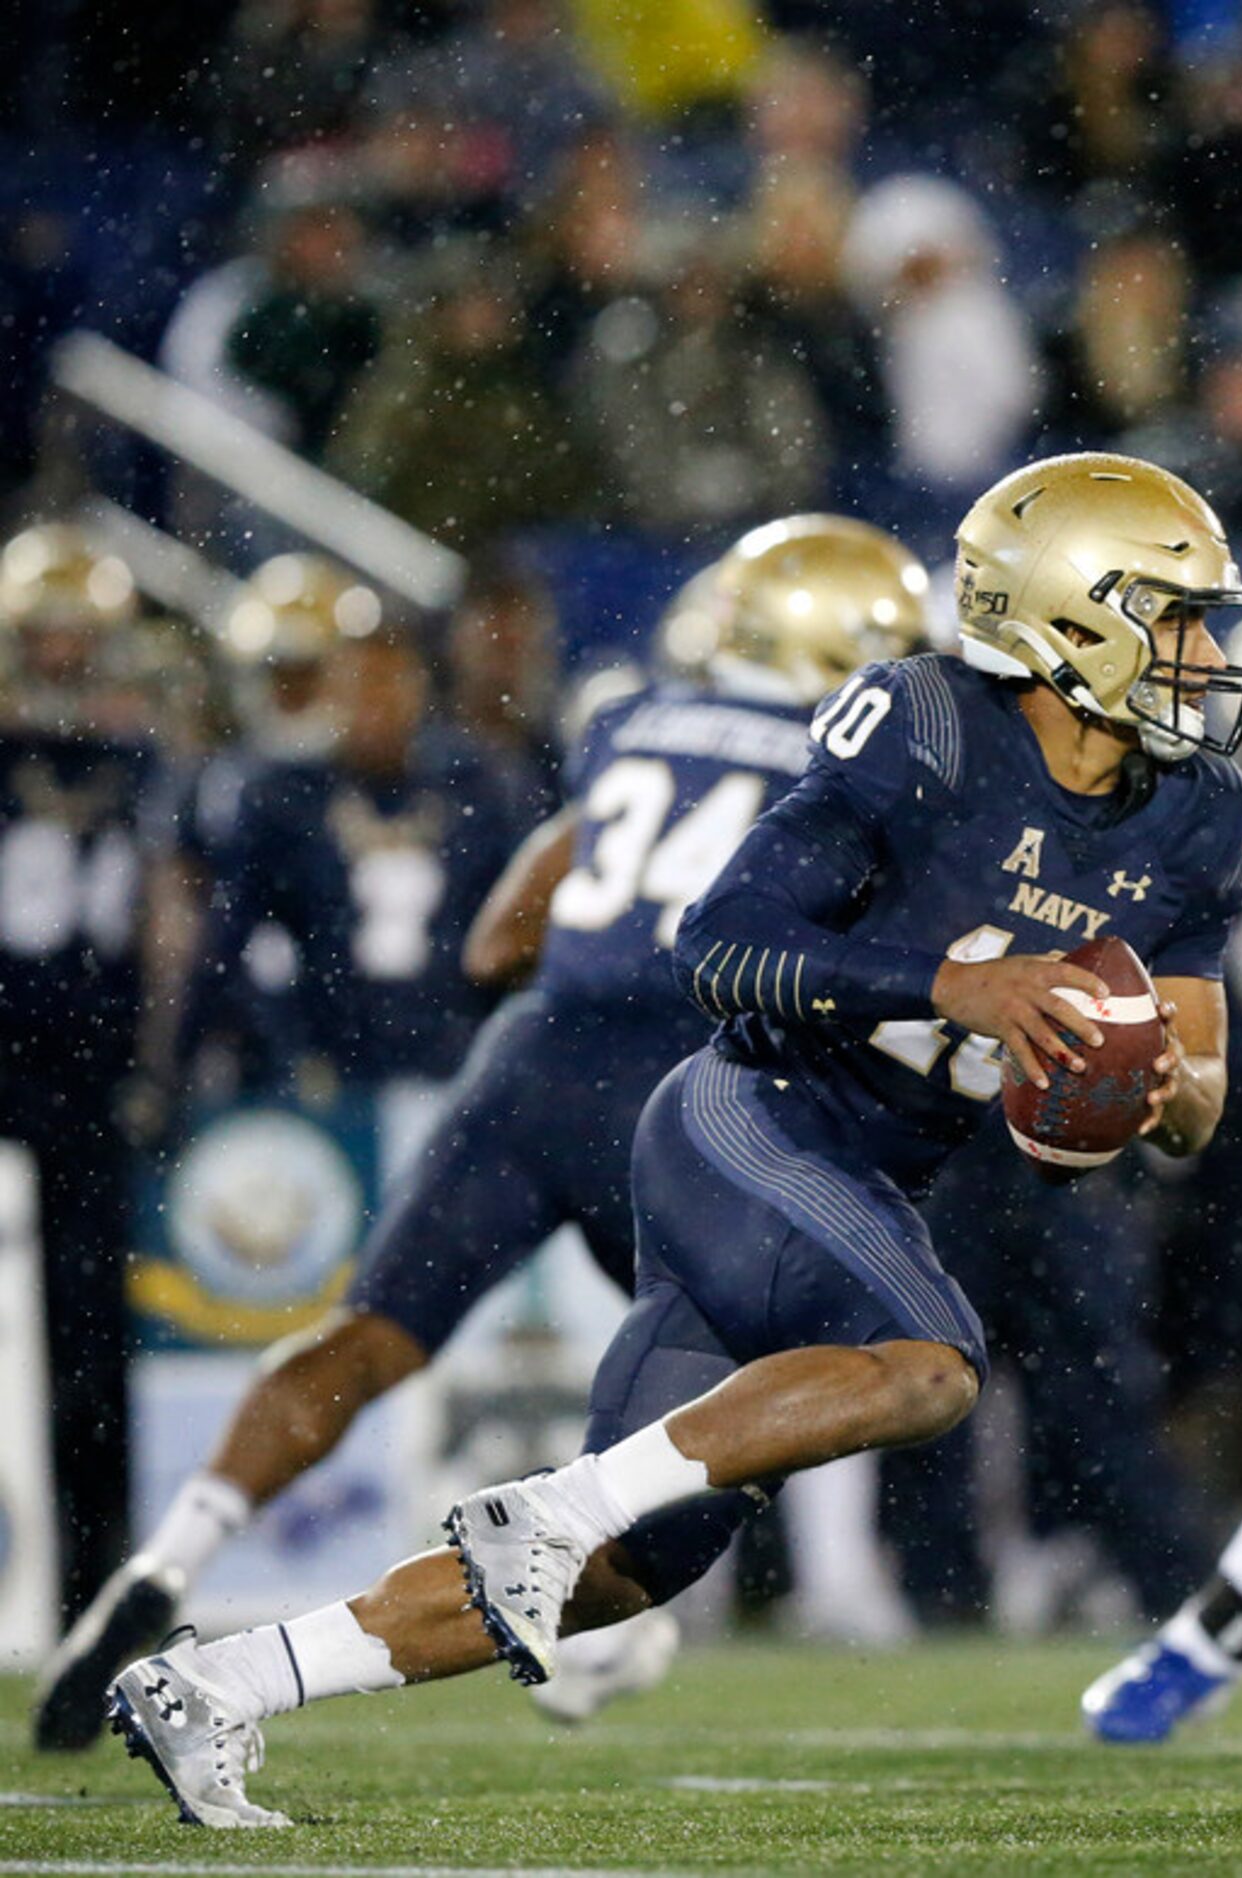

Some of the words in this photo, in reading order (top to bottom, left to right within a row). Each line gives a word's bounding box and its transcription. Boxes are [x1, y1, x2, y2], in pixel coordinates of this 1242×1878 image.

[810, 676, 892, 760] 10
[550, 756, 768, 951] 34
[1002, 827, 1045, 879] A
[1008, 882, 1112, 940] NAVY
